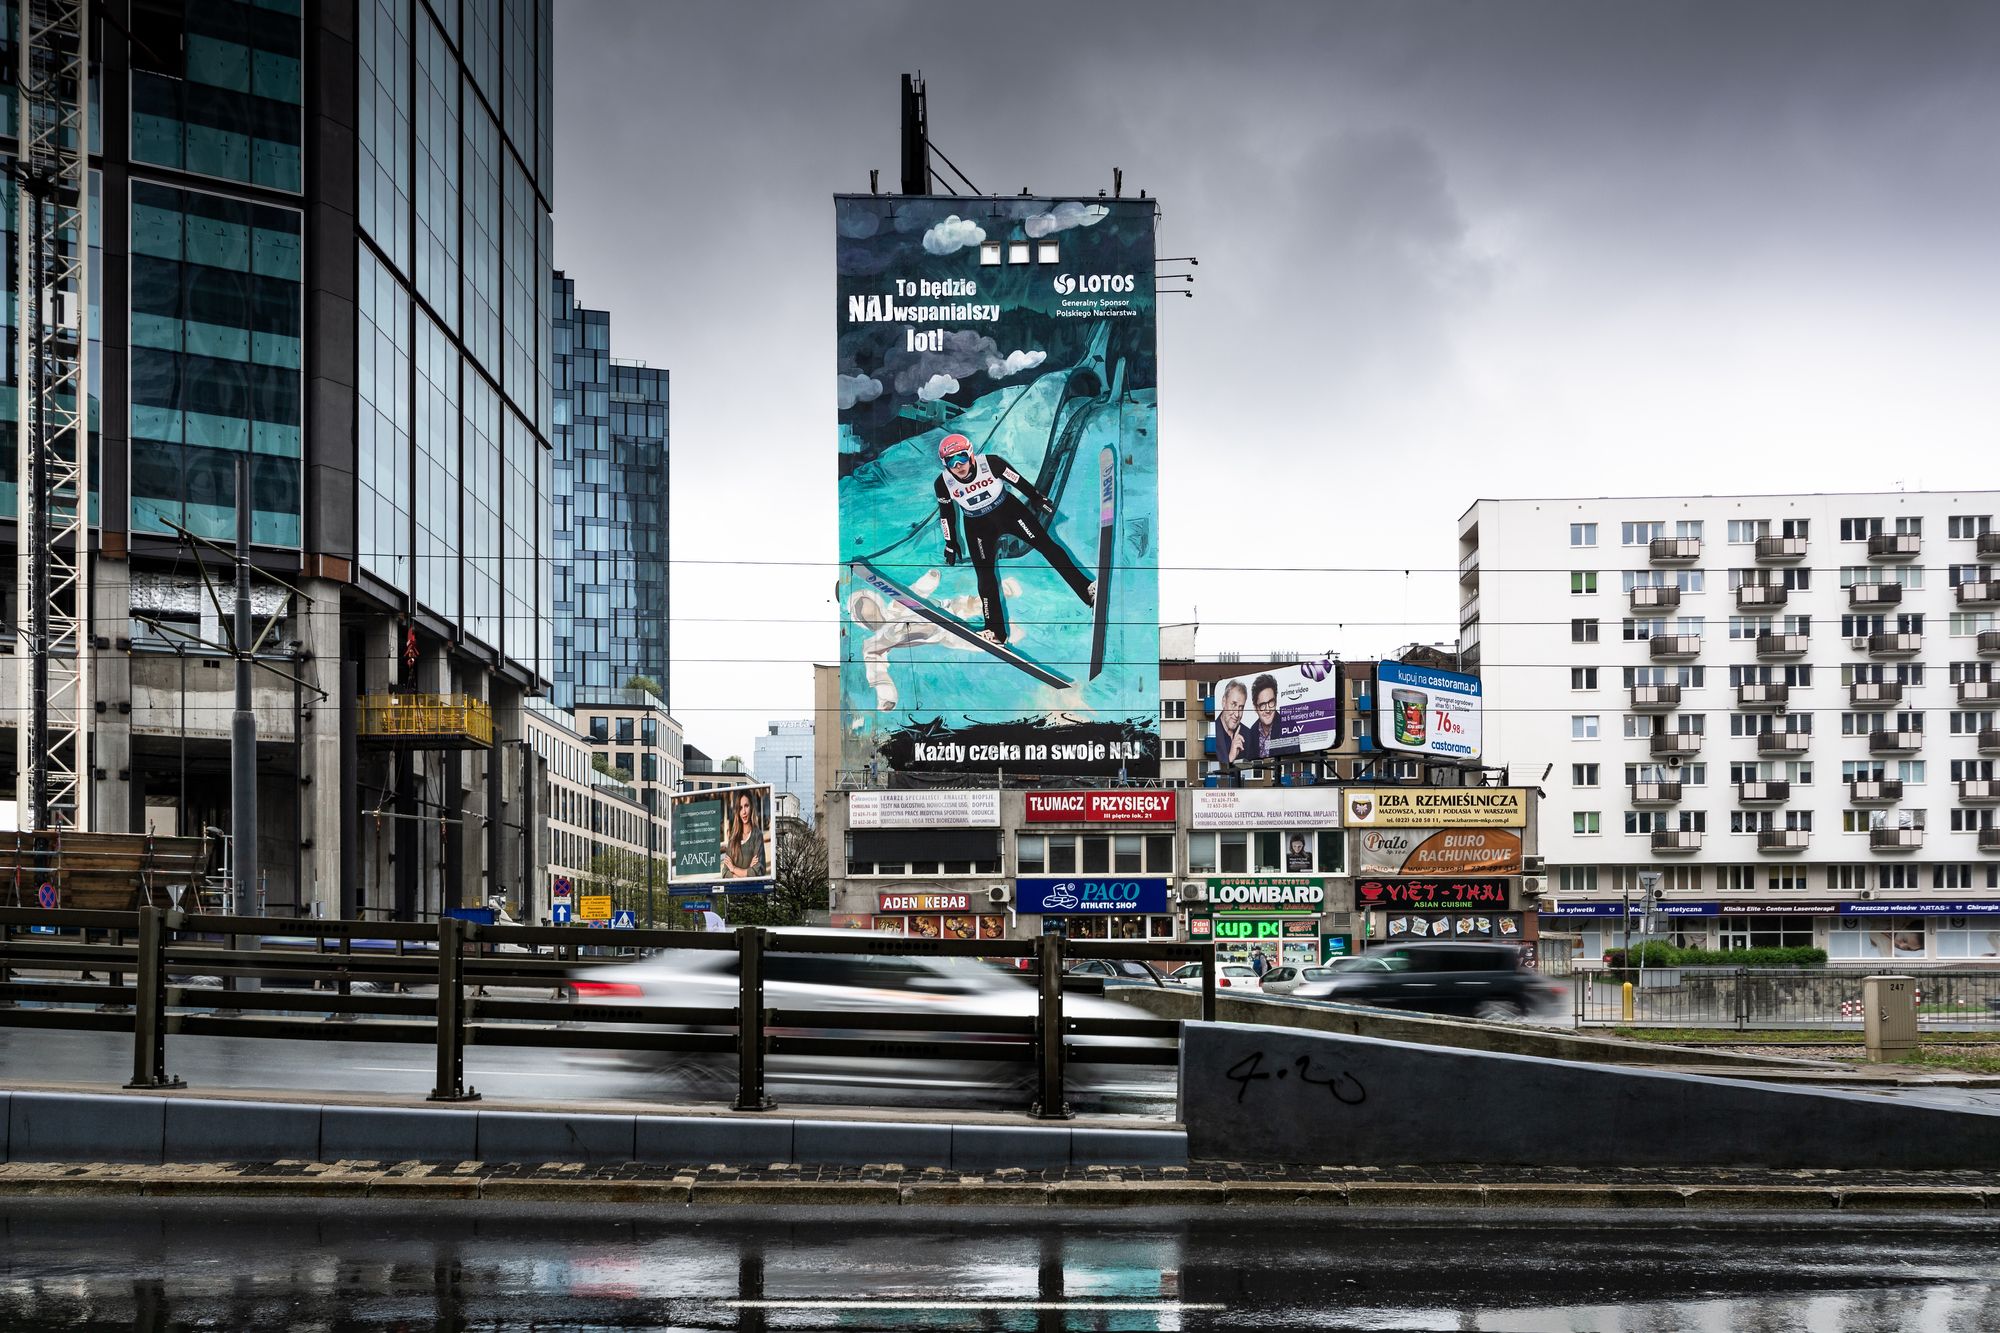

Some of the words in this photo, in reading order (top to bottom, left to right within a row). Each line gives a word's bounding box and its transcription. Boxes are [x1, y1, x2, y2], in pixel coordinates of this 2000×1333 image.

[896, 279, 917, 300] To
[921, 278, 976, 300] będzie
[1079, 274, 1135, 293] LOTOS
[1061, 299, 1097, 308] Generalny
[1100, 299, 1129, 308] Sponsor
[1056, 310, 1091, 318] Polskiego
[1093, 309, 1137, 318] Narciarstwa
[907, 328, 944, 352] lot!
[965, 477, 994, 494] LOTOS
[1398, 670, 1417, 686] kupuj
[1418, 675, 1427, 684] na
[1428, 677, 1478, 694] castorama.pl
[1281, 688, 1295, 698] prime
[1281, 725, 1304, 735] PLAY
[914, 742, 966, 763] Każdy
[969, 742, 1021, 761] czeka
[1024, 744, 1047, 761] na
[1051, 740, 1106, 762] swoje
[1109, 741, 1140, 760] NAJ
[1431, 740, 1471, 754] castorama
[1030, 796, 1085, 811] TŁUMACZ
[1092, 796, 1170, 812] PRZYSIĘGŁY
[1379, 795, 1409, 806] IZBA
[1416, 793, 1518, 806] RZEMIEŚLNICZA
[1367, 833, 1409, 849] PraZo
[1444, 835, 1486, 848] BIURO
[681, 851, 716, 867] APART.pl
[1418, 849, 1511, 862] RACHUNKOWE
[1081, 882, 1140, 901] PACO
[1209, 886, 1324, 903] LOOMBARD
[883, 897, 918, 909] ADEN
[925, 895, 967, 908] KEBAB
[1967, 904, 1999, 912] Chirurgia
[1567, 906, 1595, 914] sylwetki
[1890, 983, 1904, 991] 247
